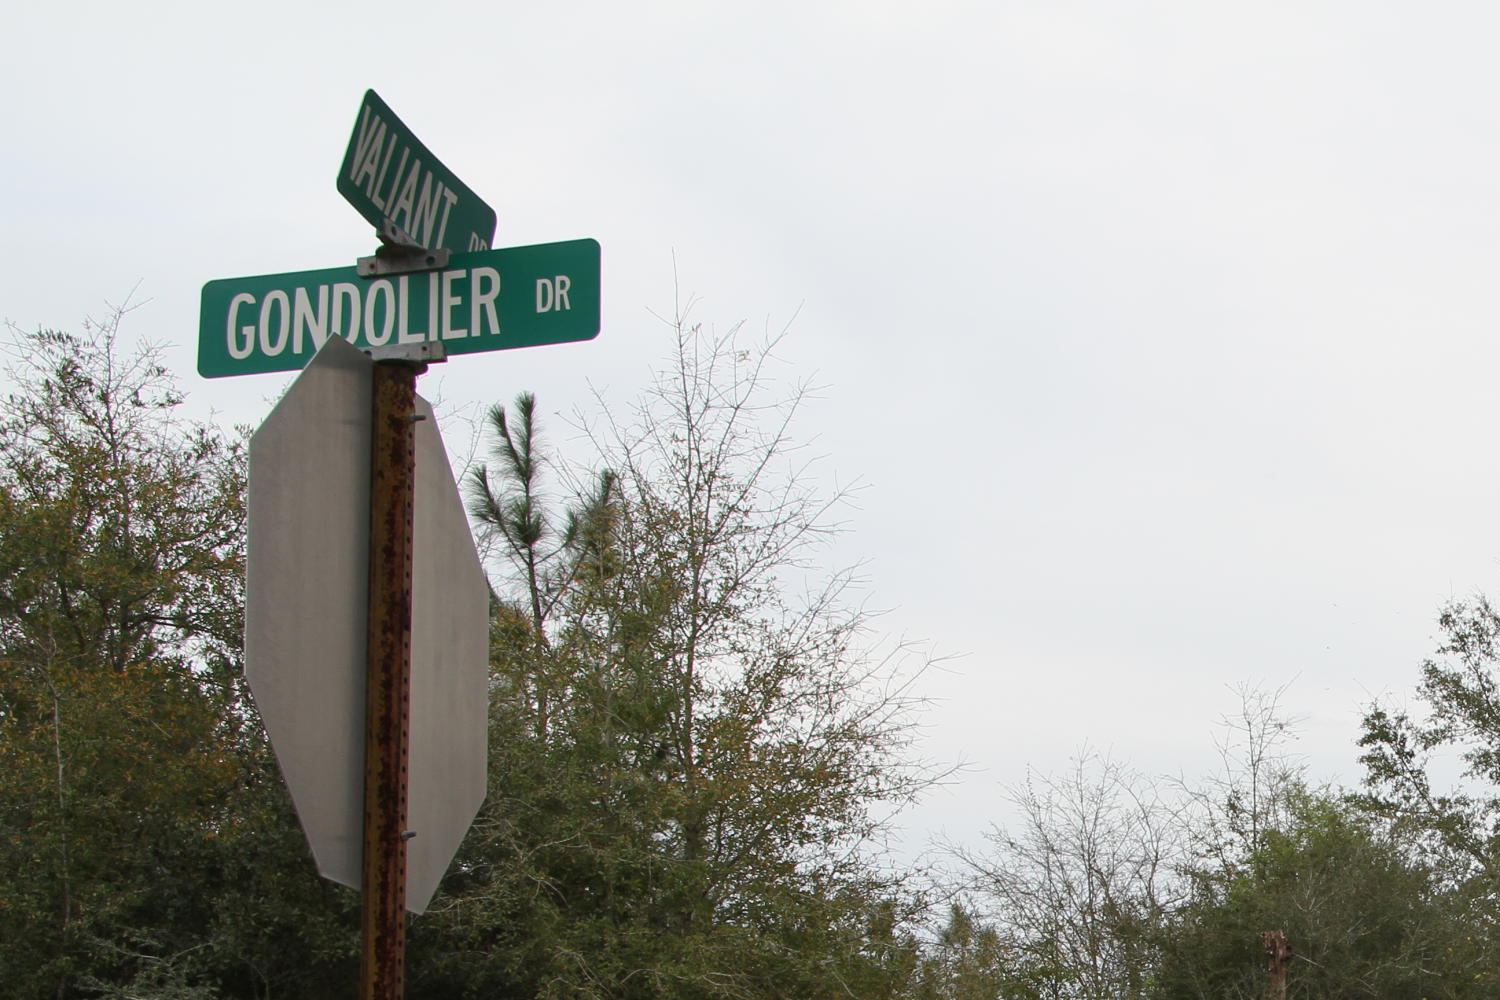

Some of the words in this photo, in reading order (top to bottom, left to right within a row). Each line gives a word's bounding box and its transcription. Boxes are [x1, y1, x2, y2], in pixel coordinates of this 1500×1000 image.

[350, 104, 459, 250] VALIANT
[226, 266, 501, 360] GONDOLIER
[535, 275, 572, 313] DR
